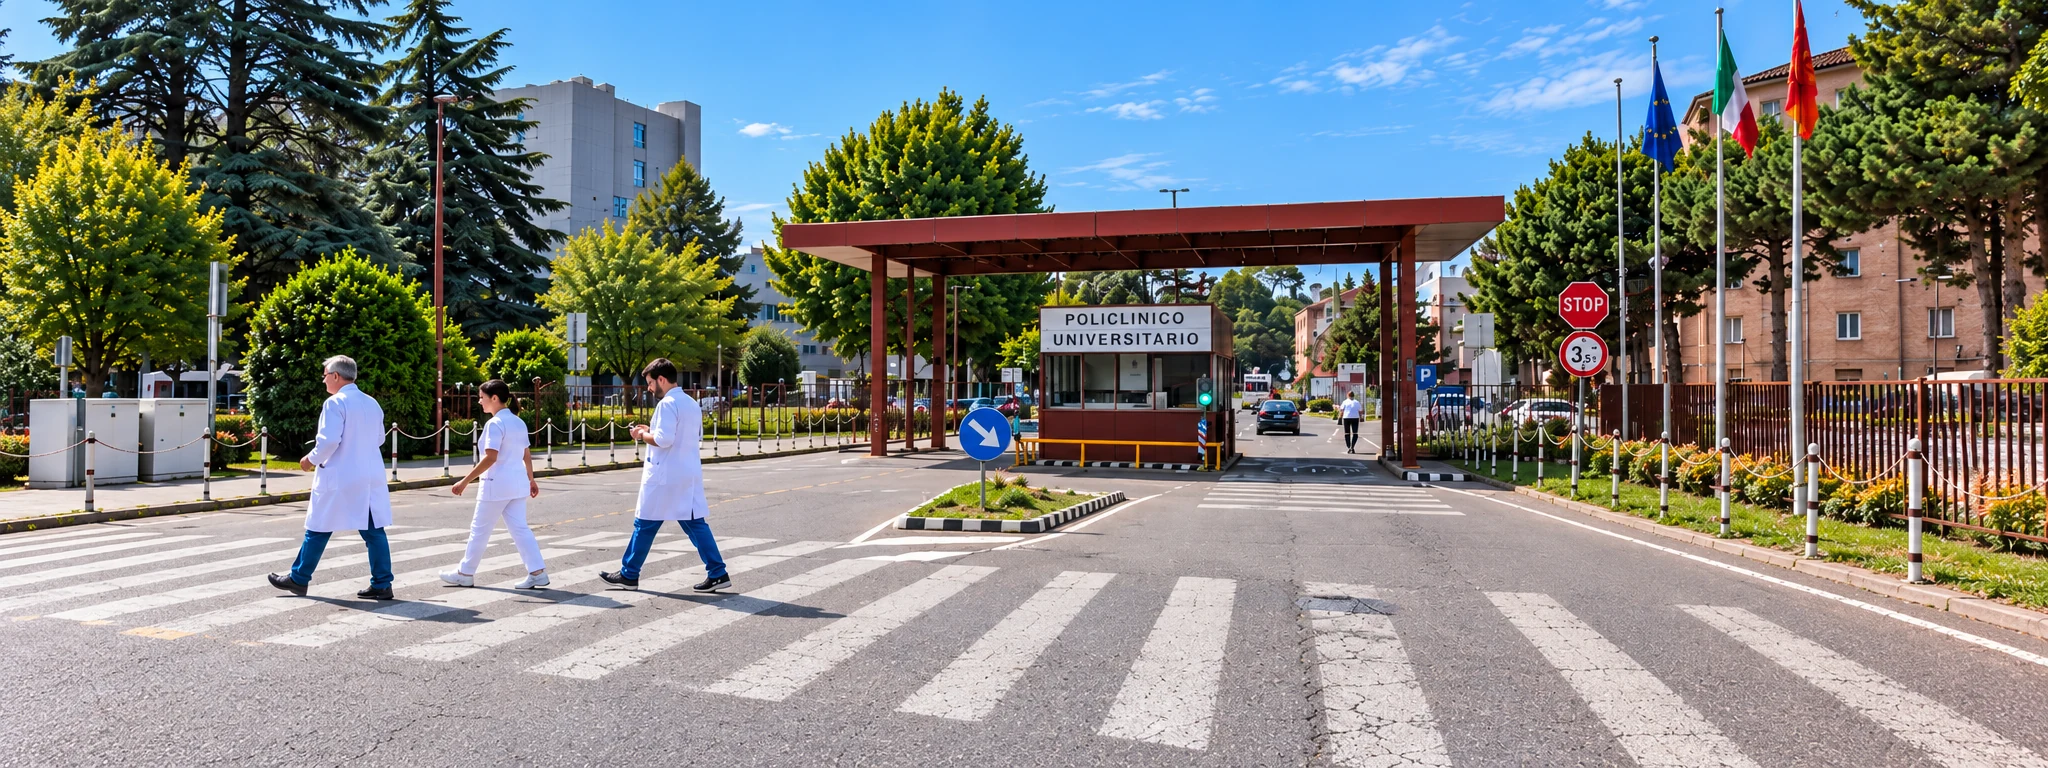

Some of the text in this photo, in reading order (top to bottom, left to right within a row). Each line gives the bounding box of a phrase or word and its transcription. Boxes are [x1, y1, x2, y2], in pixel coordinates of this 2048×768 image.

[1563, 297, 1604, 312] STOP
[1065, 311, 1185, 326] POLICLINICO
[1053, 332, 1199, 346] UNIVERSITARIO
[1420, 368, 1432, 382] P
